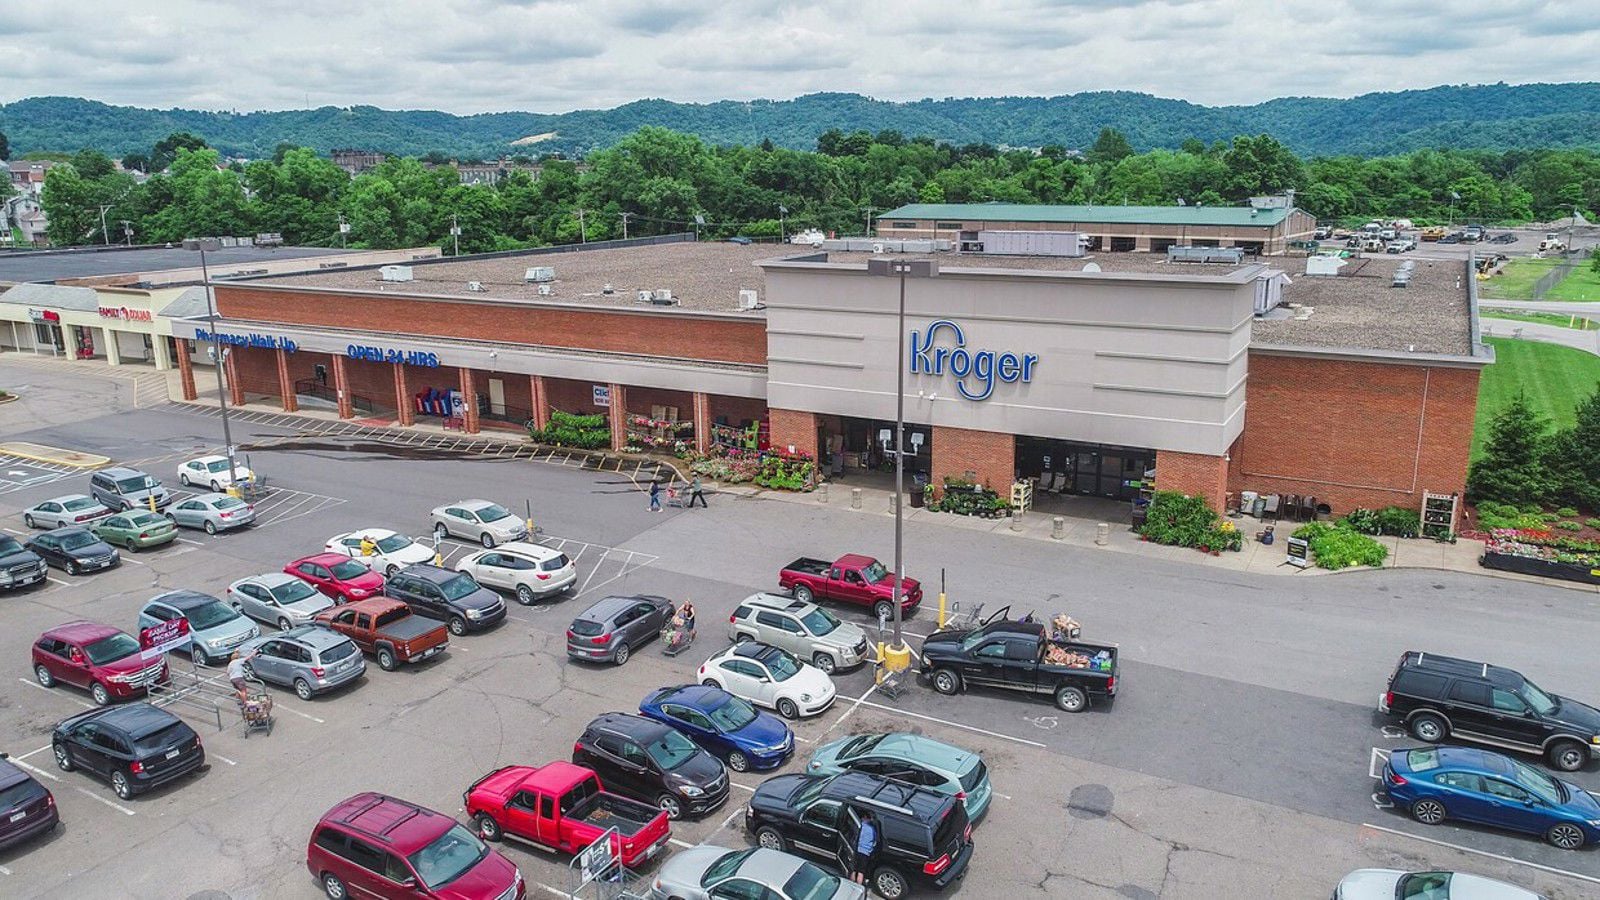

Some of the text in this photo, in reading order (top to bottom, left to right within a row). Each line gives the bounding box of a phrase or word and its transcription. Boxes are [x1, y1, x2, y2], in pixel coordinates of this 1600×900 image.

[99, 306, 151, 321] FAMILY DOLLAR
[249, 333, 275, 349] Walk
[279, 336, 297, 353] Up
[347, 344, 438, 368] OPEN 24 HRS
[909, 320, 1039, 401] Kroger
